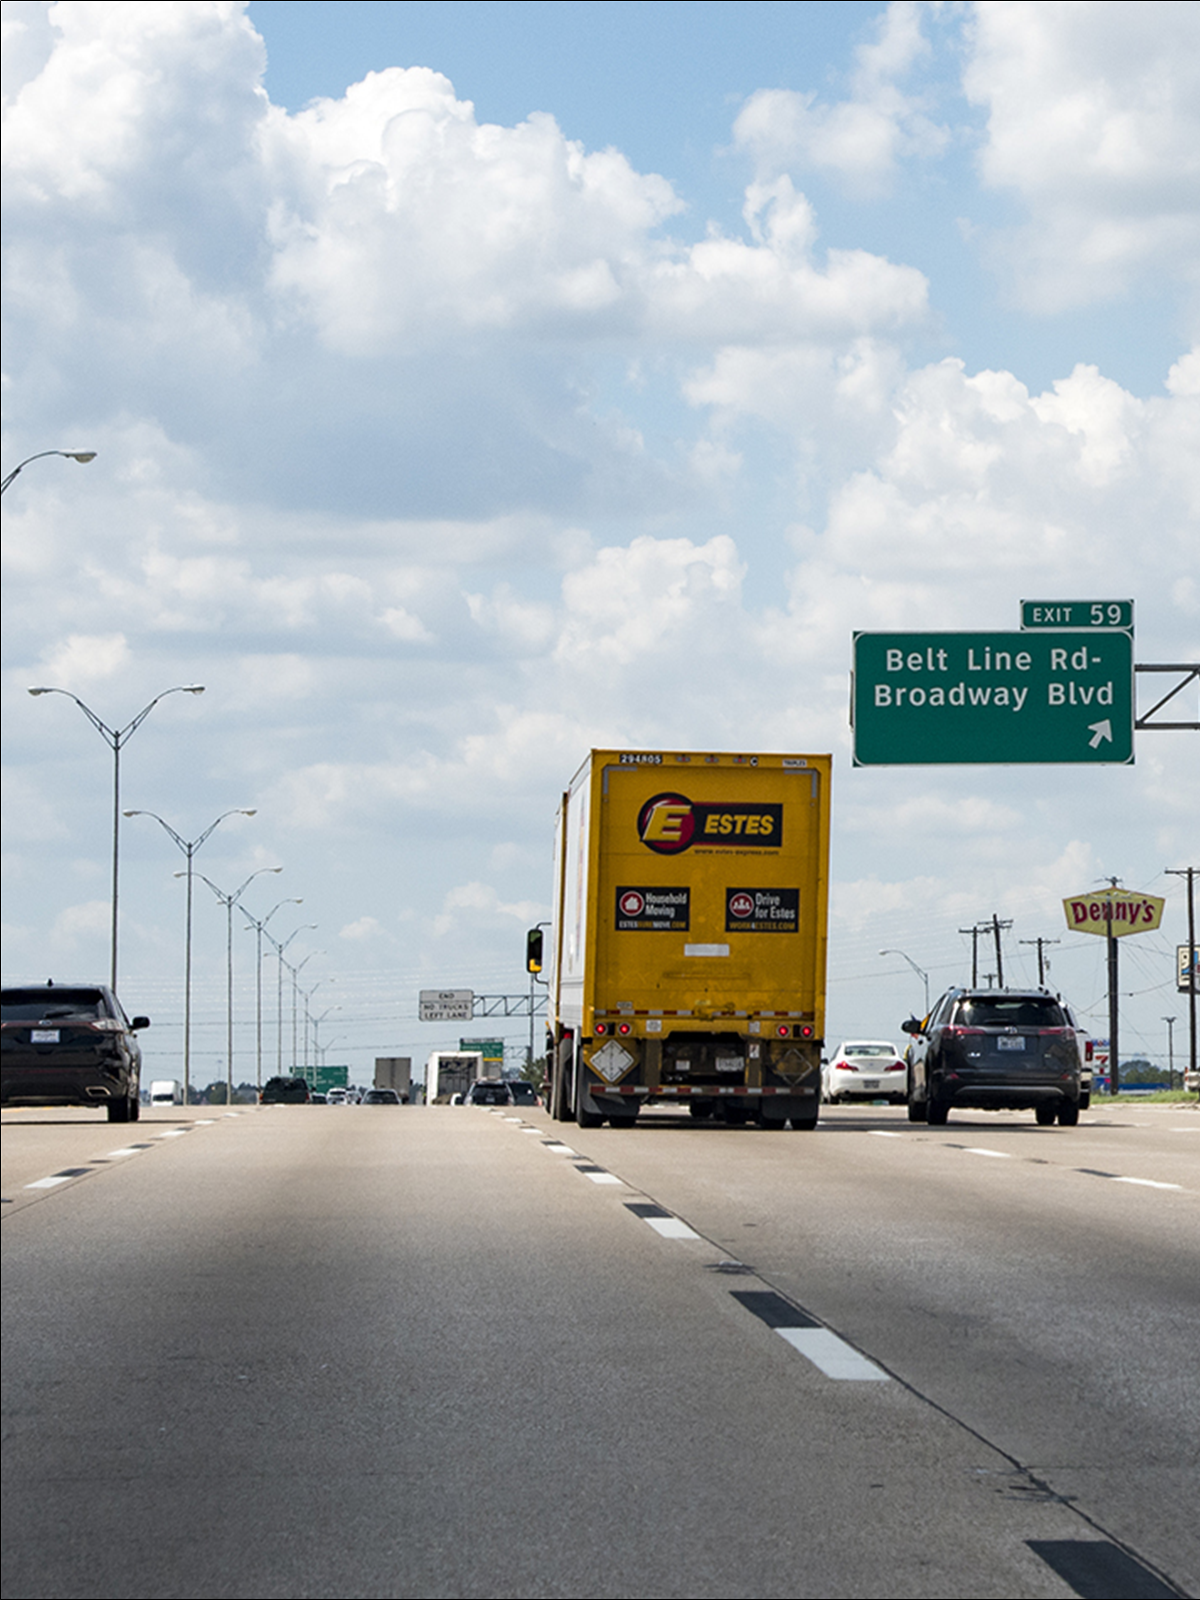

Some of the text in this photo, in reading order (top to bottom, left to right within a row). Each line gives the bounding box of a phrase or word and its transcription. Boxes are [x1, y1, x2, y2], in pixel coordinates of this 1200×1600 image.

[1032, 604, 1122, 625] EXIT 59
[886, 646, 1102, 671] Belt Line Rd-
[874, 681, 1114, 711] Broadway Blvd
[704, 814, 775, 836] ESTES
[646, 892, 688, 905] Household
[755, 892, 781, 906] Drive
[645, 904, 676, 919] Moving
[755, 905, 796, 920] for Estes
[1070, 899, 1155, 925] Denny's
